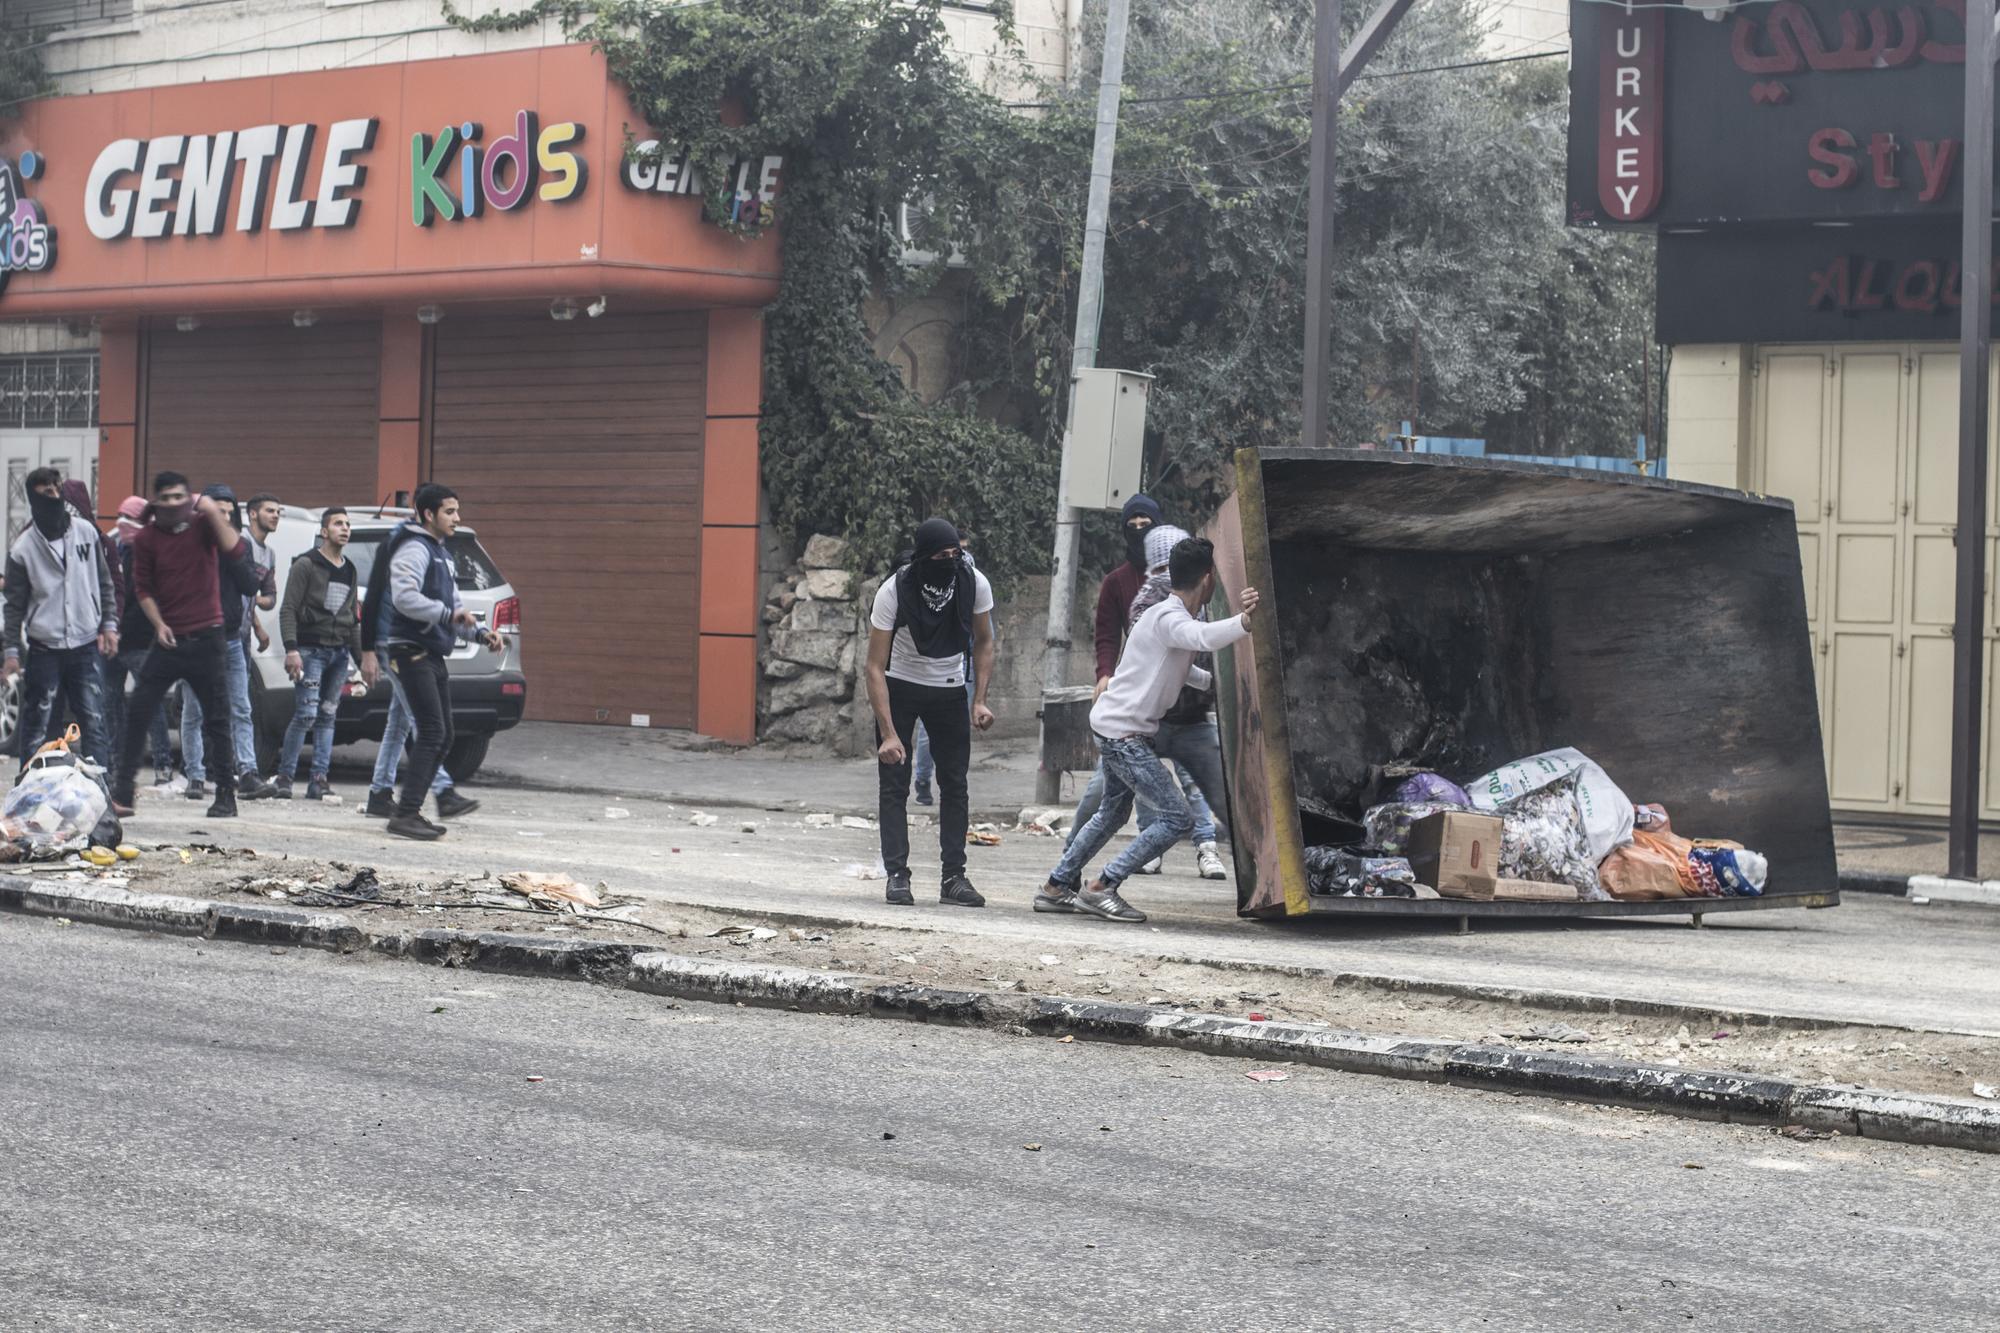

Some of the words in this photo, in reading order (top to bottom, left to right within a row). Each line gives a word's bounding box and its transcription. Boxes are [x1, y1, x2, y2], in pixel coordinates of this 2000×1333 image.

[84, 116, 374, 240] GENTLE
[411, 108, 584, 228] Kids
[1807, 127, 1960, 202] Sty
[717, 190, 775, 225] ids
[75, 542, 92, 562] W
